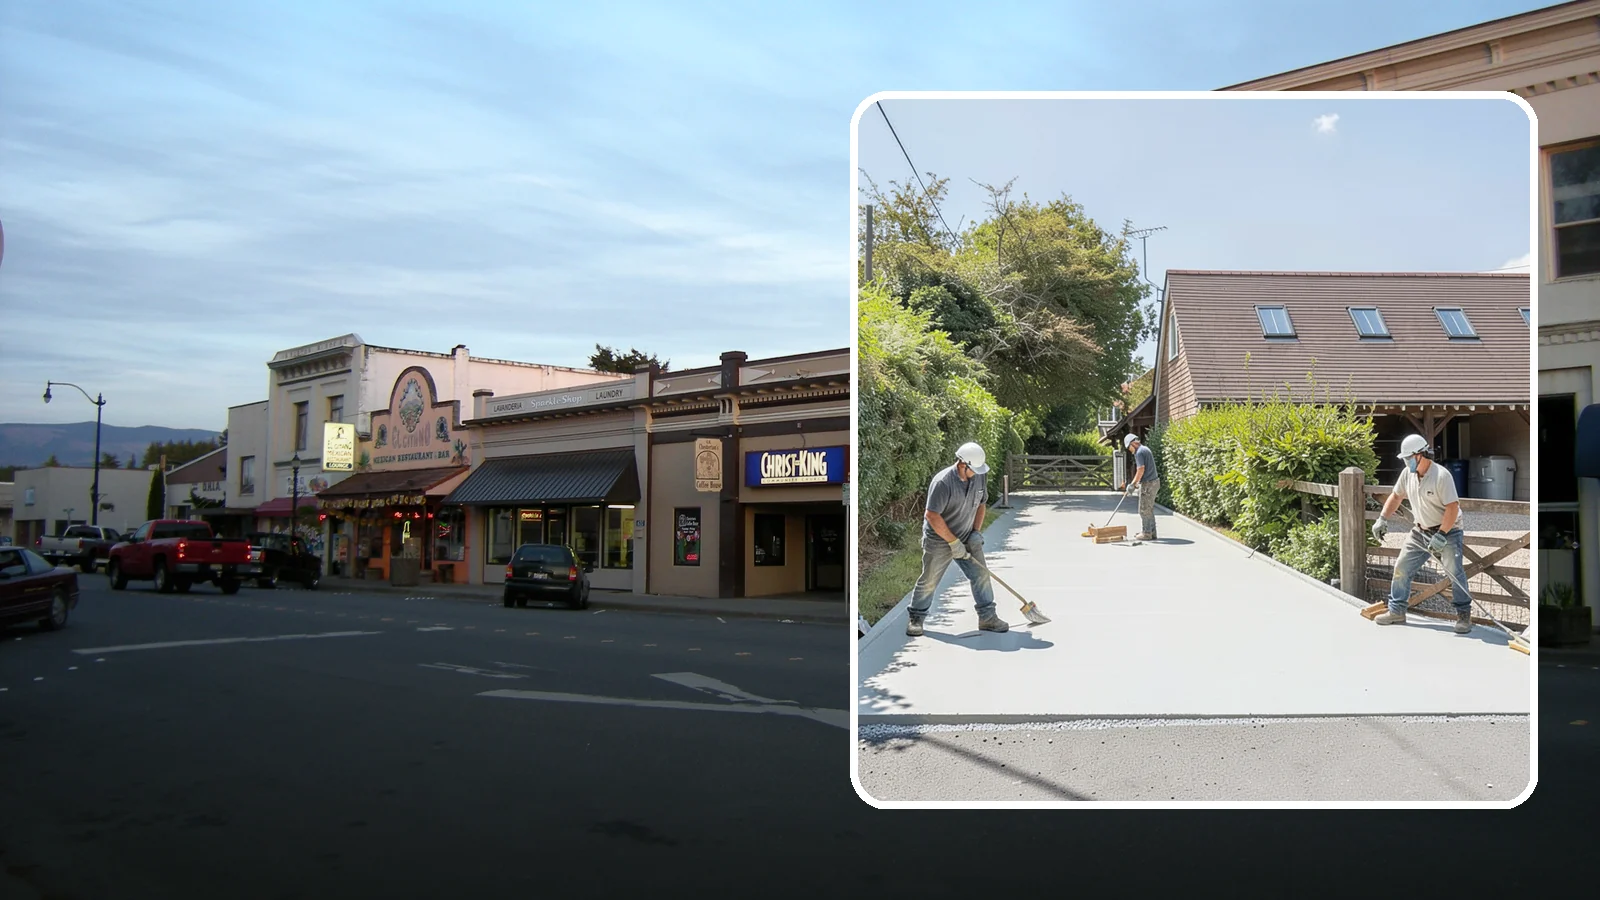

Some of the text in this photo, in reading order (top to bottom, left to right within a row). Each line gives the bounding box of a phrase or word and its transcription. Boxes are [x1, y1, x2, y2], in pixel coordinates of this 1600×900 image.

[493, 402, 523, 413] LAVANDERIA
[562, 394, 582, 405] Shop
[596, 389, 623, 400] LAUNDRY
[373, 454, 396, 464] MEXICAN
[397, 451, 433, 463] RESTAURANT
[438, 450, 450, 459] BAR
[761, 450, 827, 478] CHRIST KING
[697, 481, 721, 489] Coffee House
